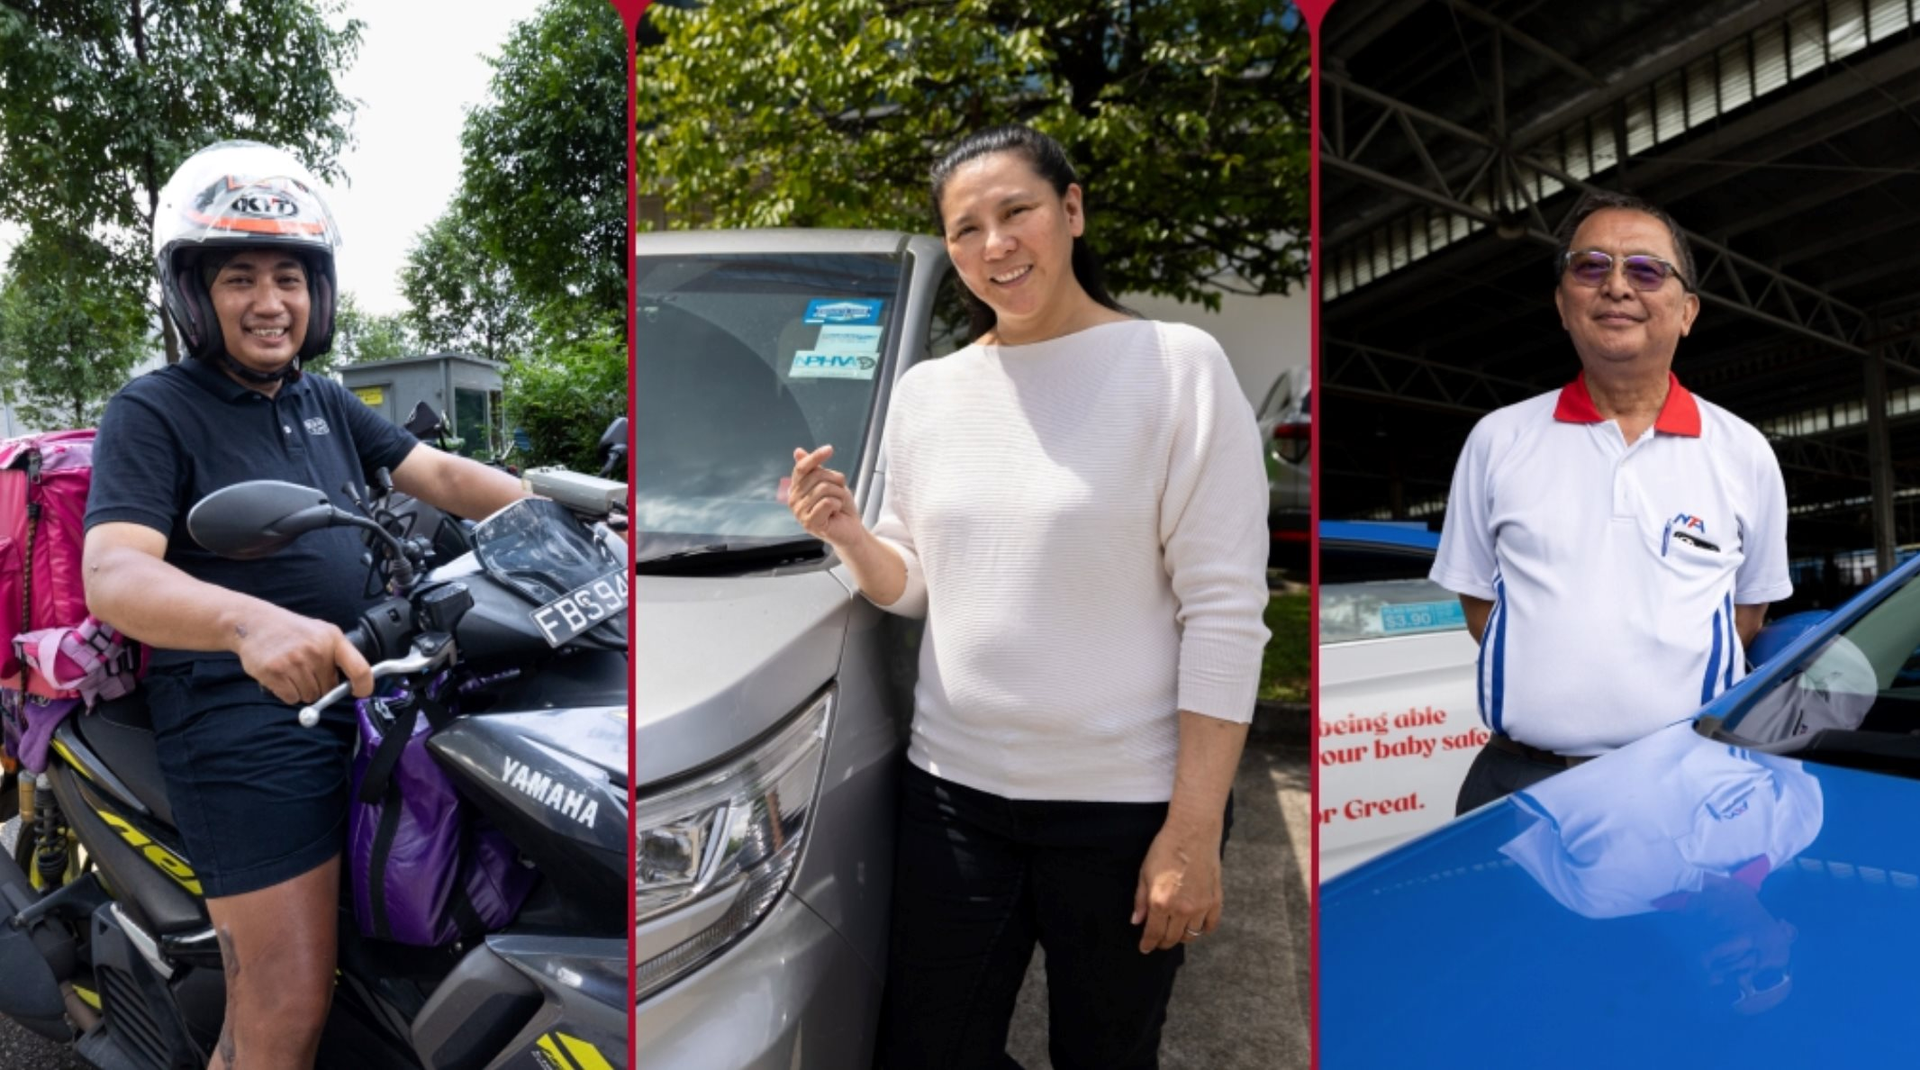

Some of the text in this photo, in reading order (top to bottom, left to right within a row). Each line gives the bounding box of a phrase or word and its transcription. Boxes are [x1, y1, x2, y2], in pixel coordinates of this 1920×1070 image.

[535, 569, 628, 643] FBS94
[1385, 612, 1432, 628] $3.90
[1394, 706, 1446, 729] able
[1319, 728, 1489, 766] our baby safe
[502, 755, 598, 830] YAMAHA
[1344, 792, 1426, 820] Great.
